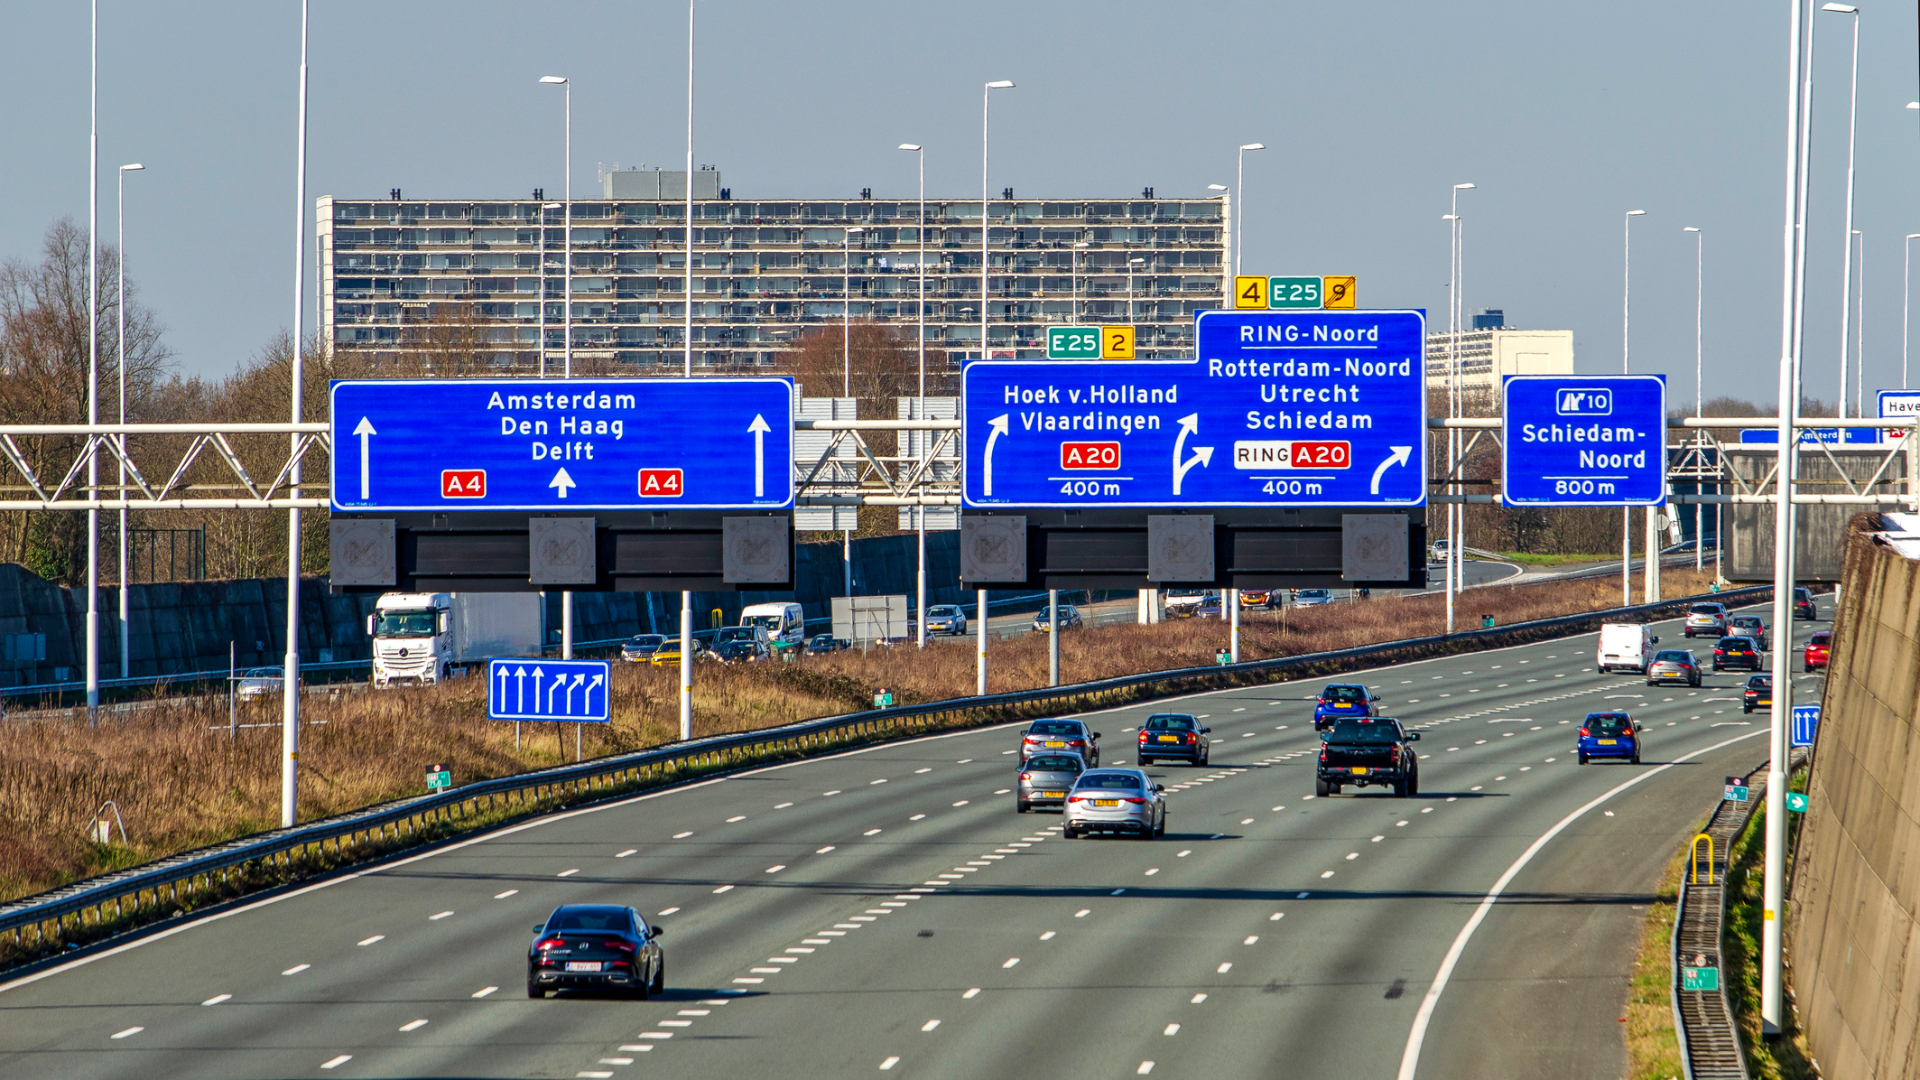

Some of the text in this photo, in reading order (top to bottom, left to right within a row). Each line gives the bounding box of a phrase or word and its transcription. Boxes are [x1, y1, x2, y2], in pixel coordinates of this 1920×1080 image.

[1241, 282, 1261, 303] 4
[1273, 284, 1318, 301] E25
[1052, 334, 1097, 351] E25
[1240, 325, 1378, 342] RING-Noord
[1111, 334, 1126, 352] 2
[1209, 358, 1411, 377] Rotterdam-Noord
[487, 391, 636, 410] Amsterdam
[1004, 384, 1178, 404] Hoek v.Holland
[1260, 384, 1360, 403] Utrecht
[1587, 394, 1607, 409] 10
[501, 416, 624, 440] Den Haag
[1020, 411, 1161, 436] Vlaardingen
[1246, 411, 1373, 430] Schiedam
[1522, 423, 1646, 443] Schiedam-
[532, 441, 594, 460] Delft
[1067, 448, 1116, 465] A20
[1238, 446, 1345, 464] RING A20
[1579, 450, 1646, 469] Noord
[448, 475, 481, 493] A4
[645, 474, 679, 492] A4
[1060, 481, 1120, 496] 400 m
[1262, 480, 1322, 495] 400 m
[1555, 480, 1615, 495] 800 m
